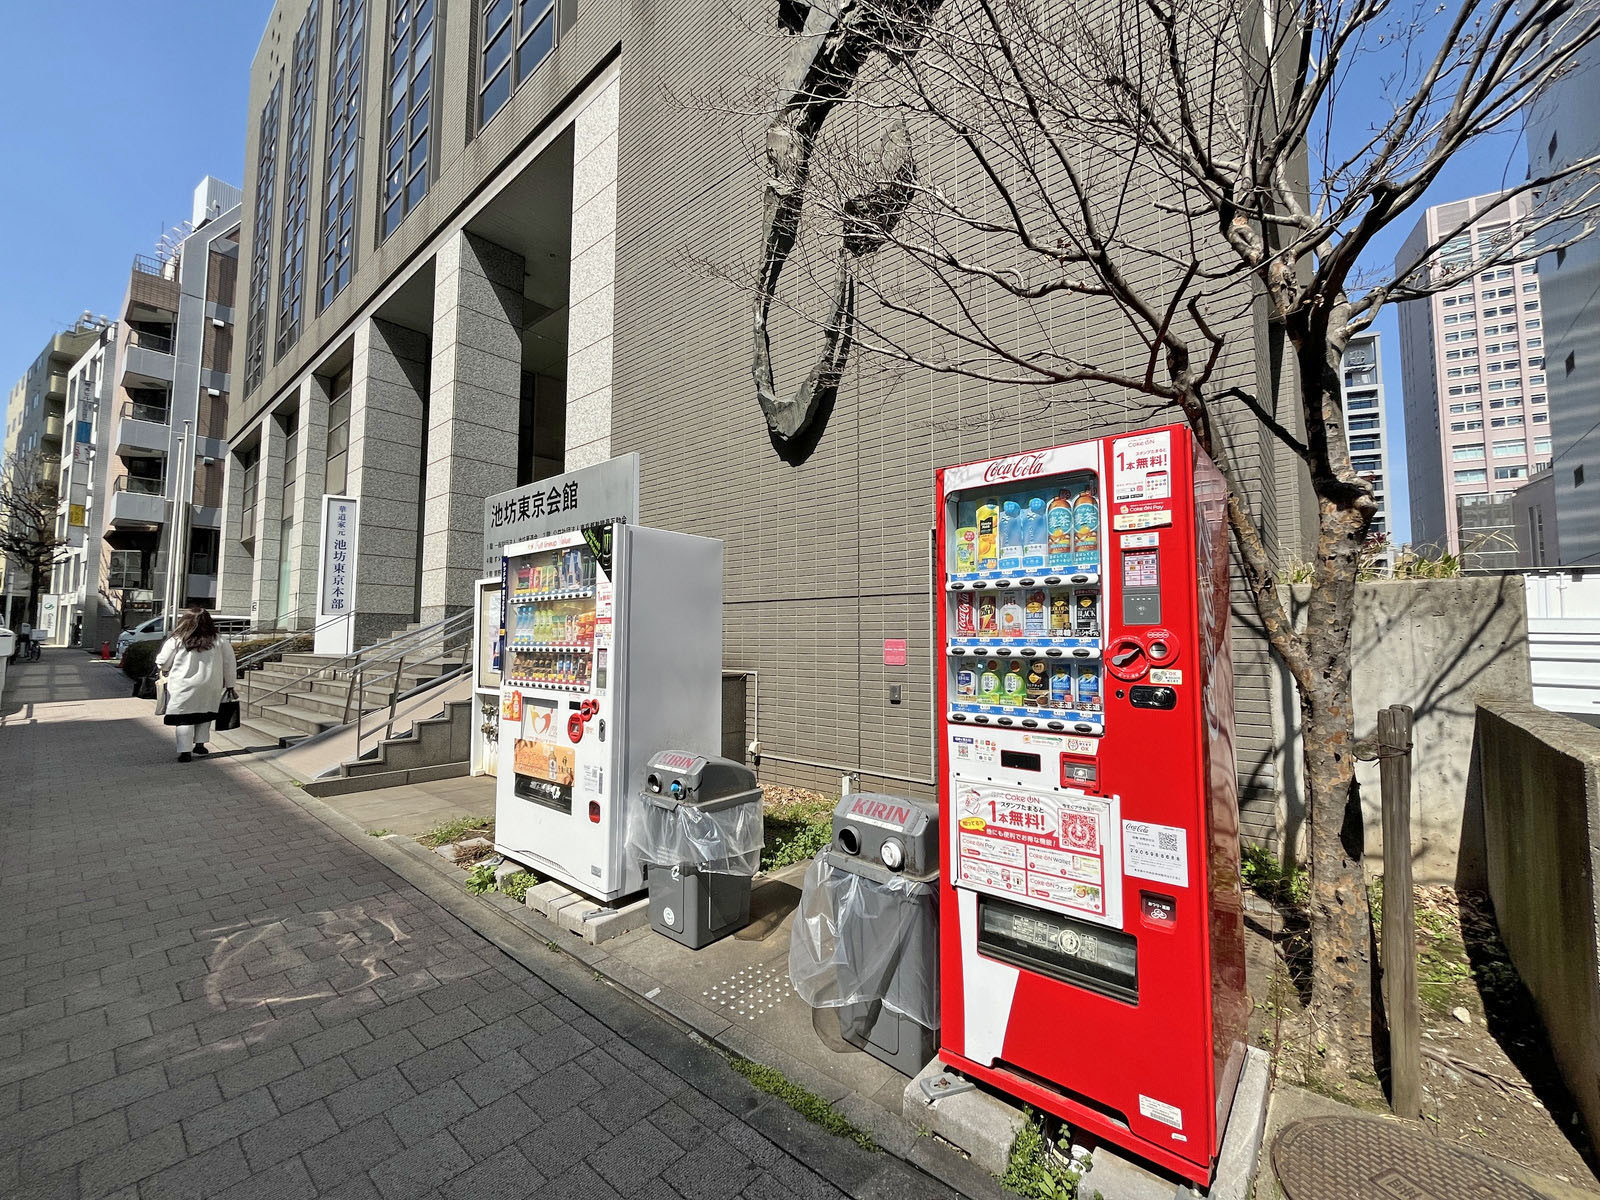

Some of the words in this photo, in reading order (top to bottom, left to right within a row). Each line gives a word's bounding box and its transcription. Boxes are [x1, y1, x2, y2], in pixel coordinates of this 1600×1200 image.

[984, 452, 1047, 483] Coca-Cola
[491, 480, 579, 529] 池坊東京会館
[337, 505, 347, 536] 華道家元
[1075, 512, 1097, 526] 麦茶
[331, 539, 347, 610] 池坊東京本部
[660, 753, 696, 769] KIRIN
[1005, 793, 1026, 803] Coke
[1026, 796, 1041, 804] ON
[851, 798, 911, 825] KIRIN
[1000, 802, 1045, 814] スタンプたまると
[984, 842, 996, 851] Pay
[1053, 857, 1071, 866] Wallet
[1054, 884, 1073, 893] ウォーク
